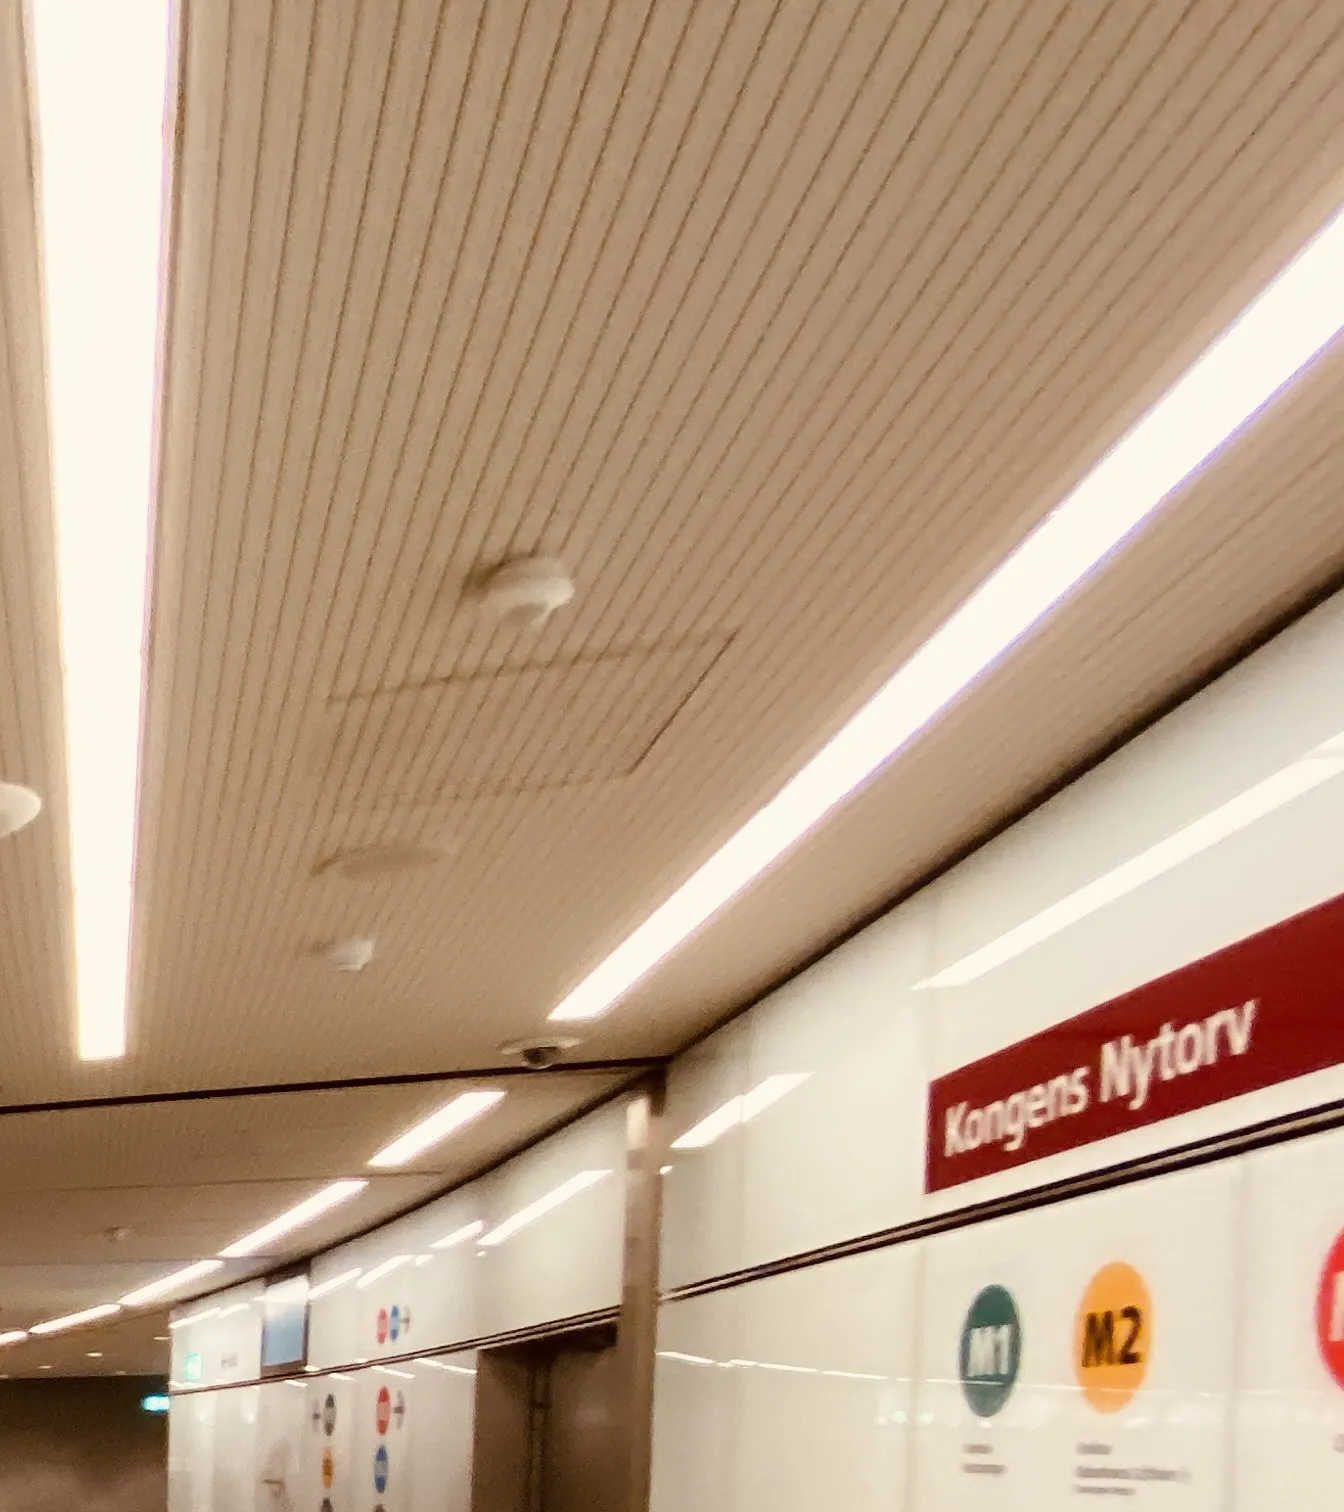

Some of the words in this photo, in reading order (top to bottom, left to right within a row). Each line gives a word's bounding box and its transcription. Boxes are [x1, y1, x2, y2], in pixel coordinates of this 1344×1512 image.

[944, 1066, 1090, 1157] Kongens
[1100, 999, 1259, 1110] Nytorv
[967, 1324, 1010, 1377] M1
[1081, 1305, 1143, 1367] M2
